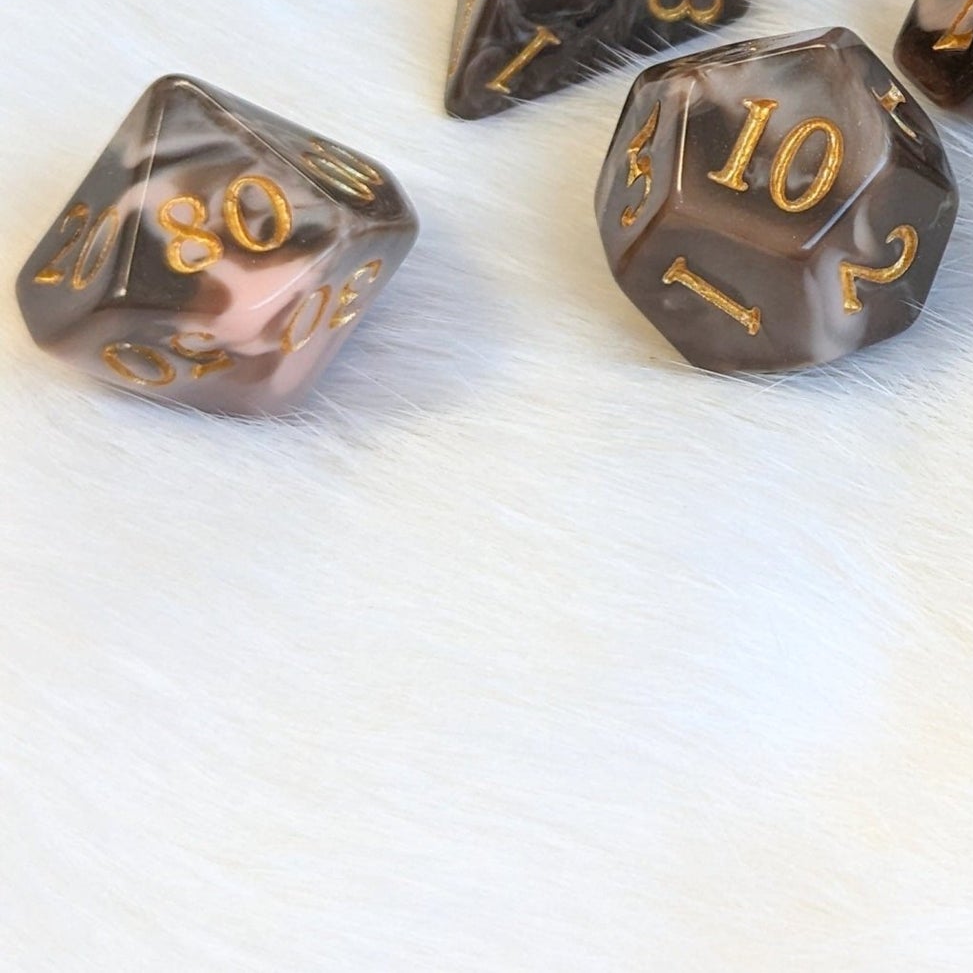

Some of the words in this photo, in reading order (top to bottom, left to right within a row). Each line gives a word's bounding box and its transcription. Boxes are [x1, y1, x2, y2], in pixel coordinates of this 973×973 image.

[485, 26, 562, 94] 1
[620, 100, 662, 227] 5
[707, 97, 844, 214] 10
[34, 202, 120, 291] 20
[157, 174, 293, 274] 80
[838, 224, 919, 316] 2
[280, 258, 383, 356] 30
[661, 256, 762, 336] 1
[103, 331, 235, 387] 50
